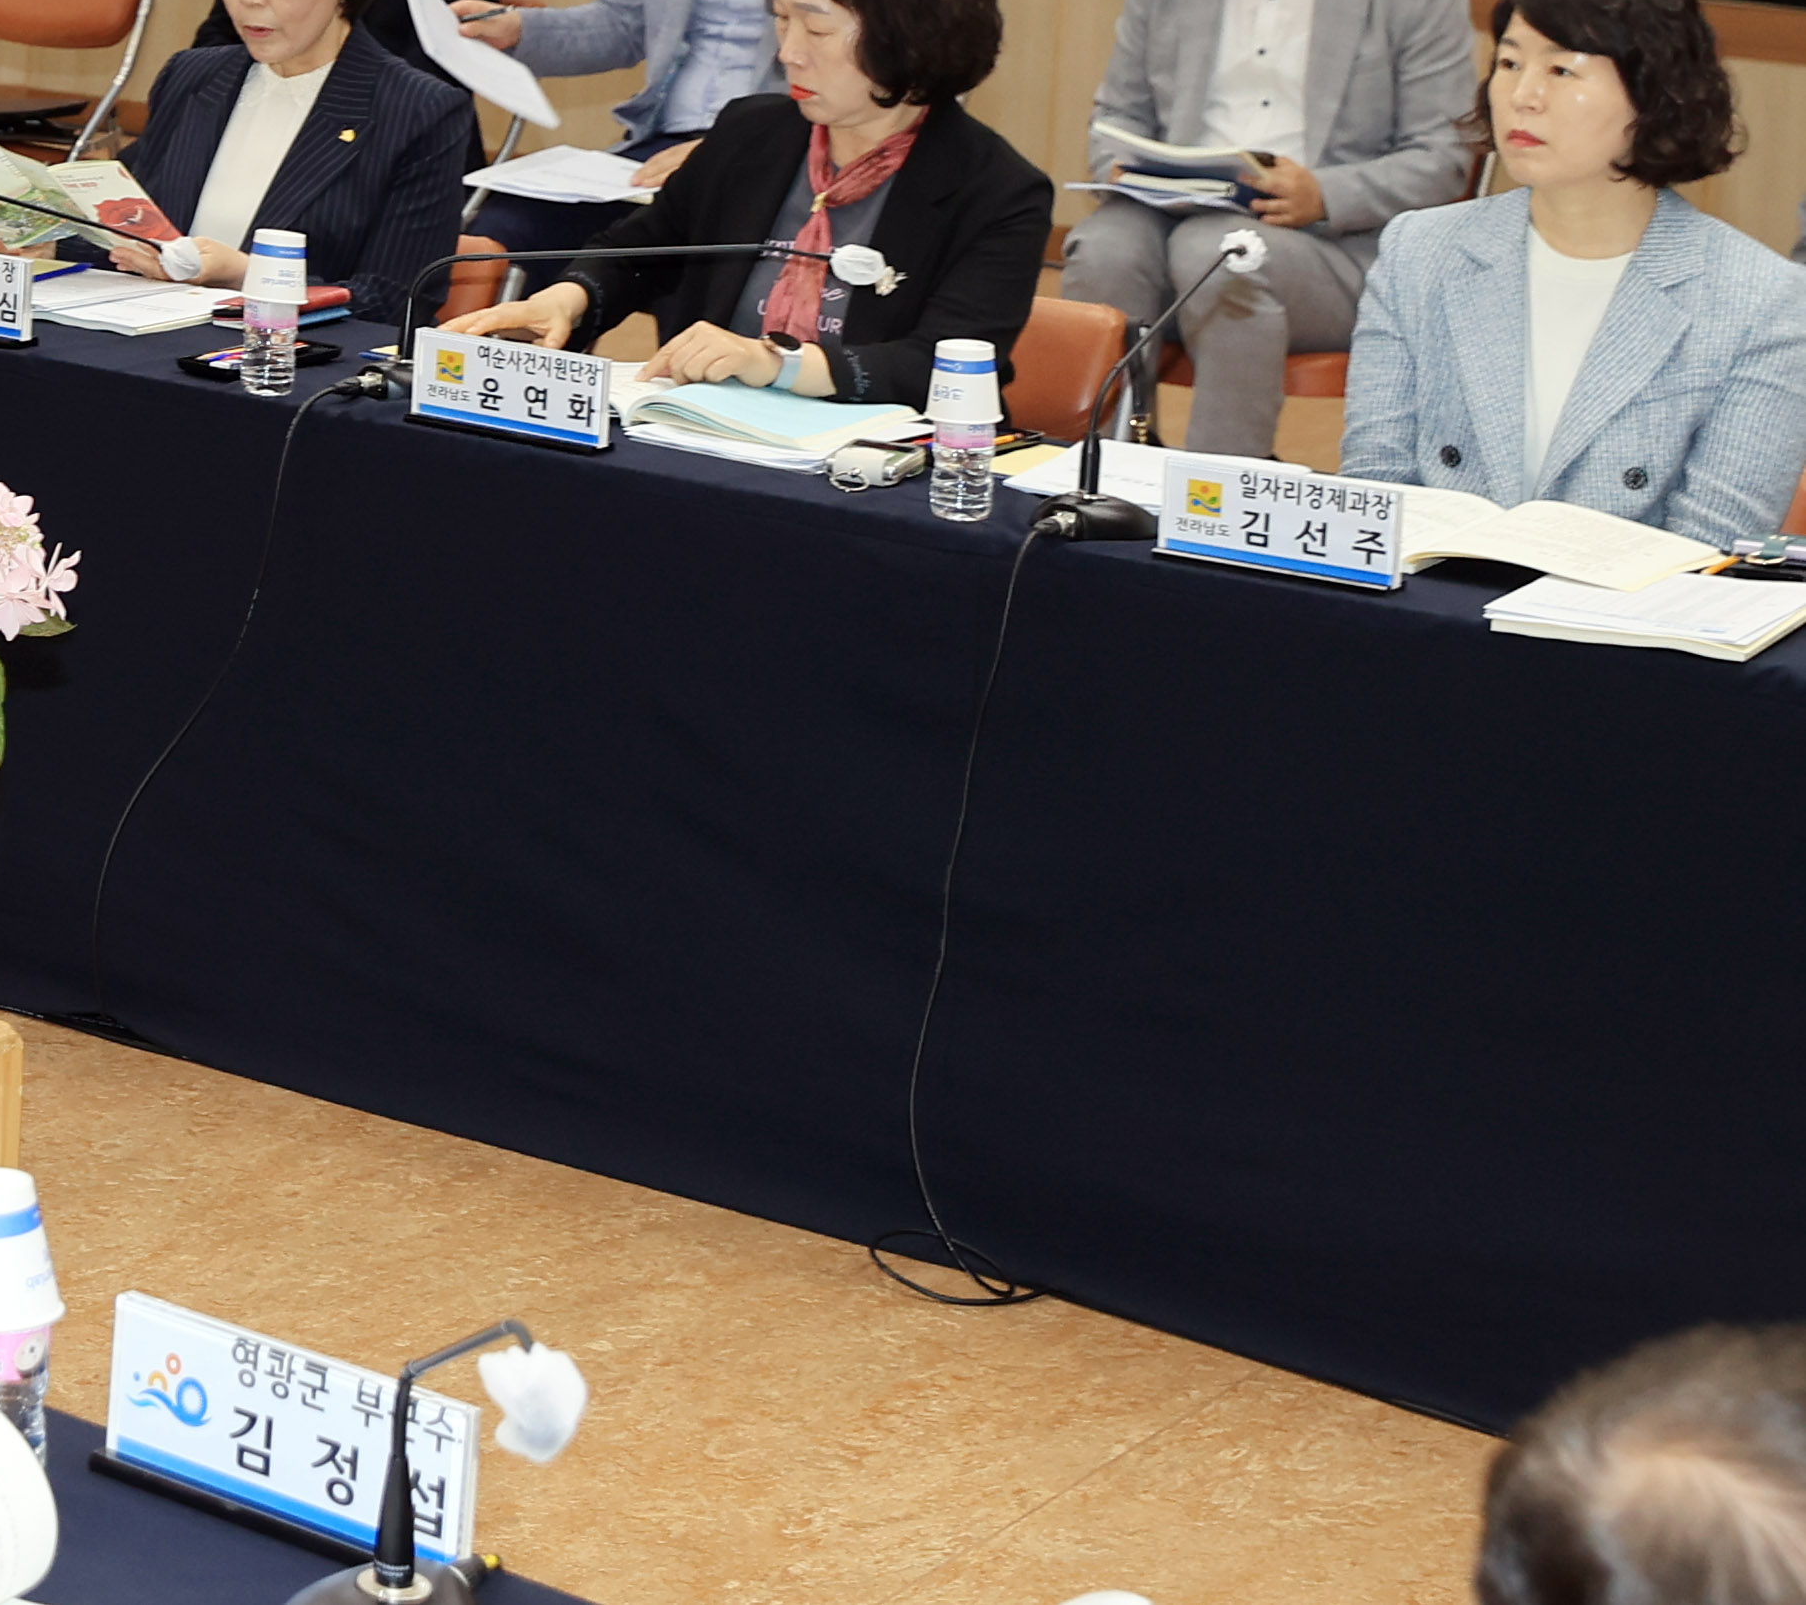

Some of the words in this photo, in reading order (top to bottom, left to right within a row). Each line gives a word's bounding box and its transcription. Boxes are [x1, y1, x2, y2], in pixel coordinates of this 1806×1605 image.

[477, 345, 602, 386] 여순사건지원단장
[427, 384, 471, 402] 전라남도
[477, 377, 595, 428] 윤연화
[1239, 472, 1393, 521] 일자리경제과장
[1175, 516, 1231, 537] 전라남도
[1239, 510, 1387, 566] 김선주
[231, 1337, 330, 1412] 영광군
[229, 1406, 447, 1540] 김정섭
